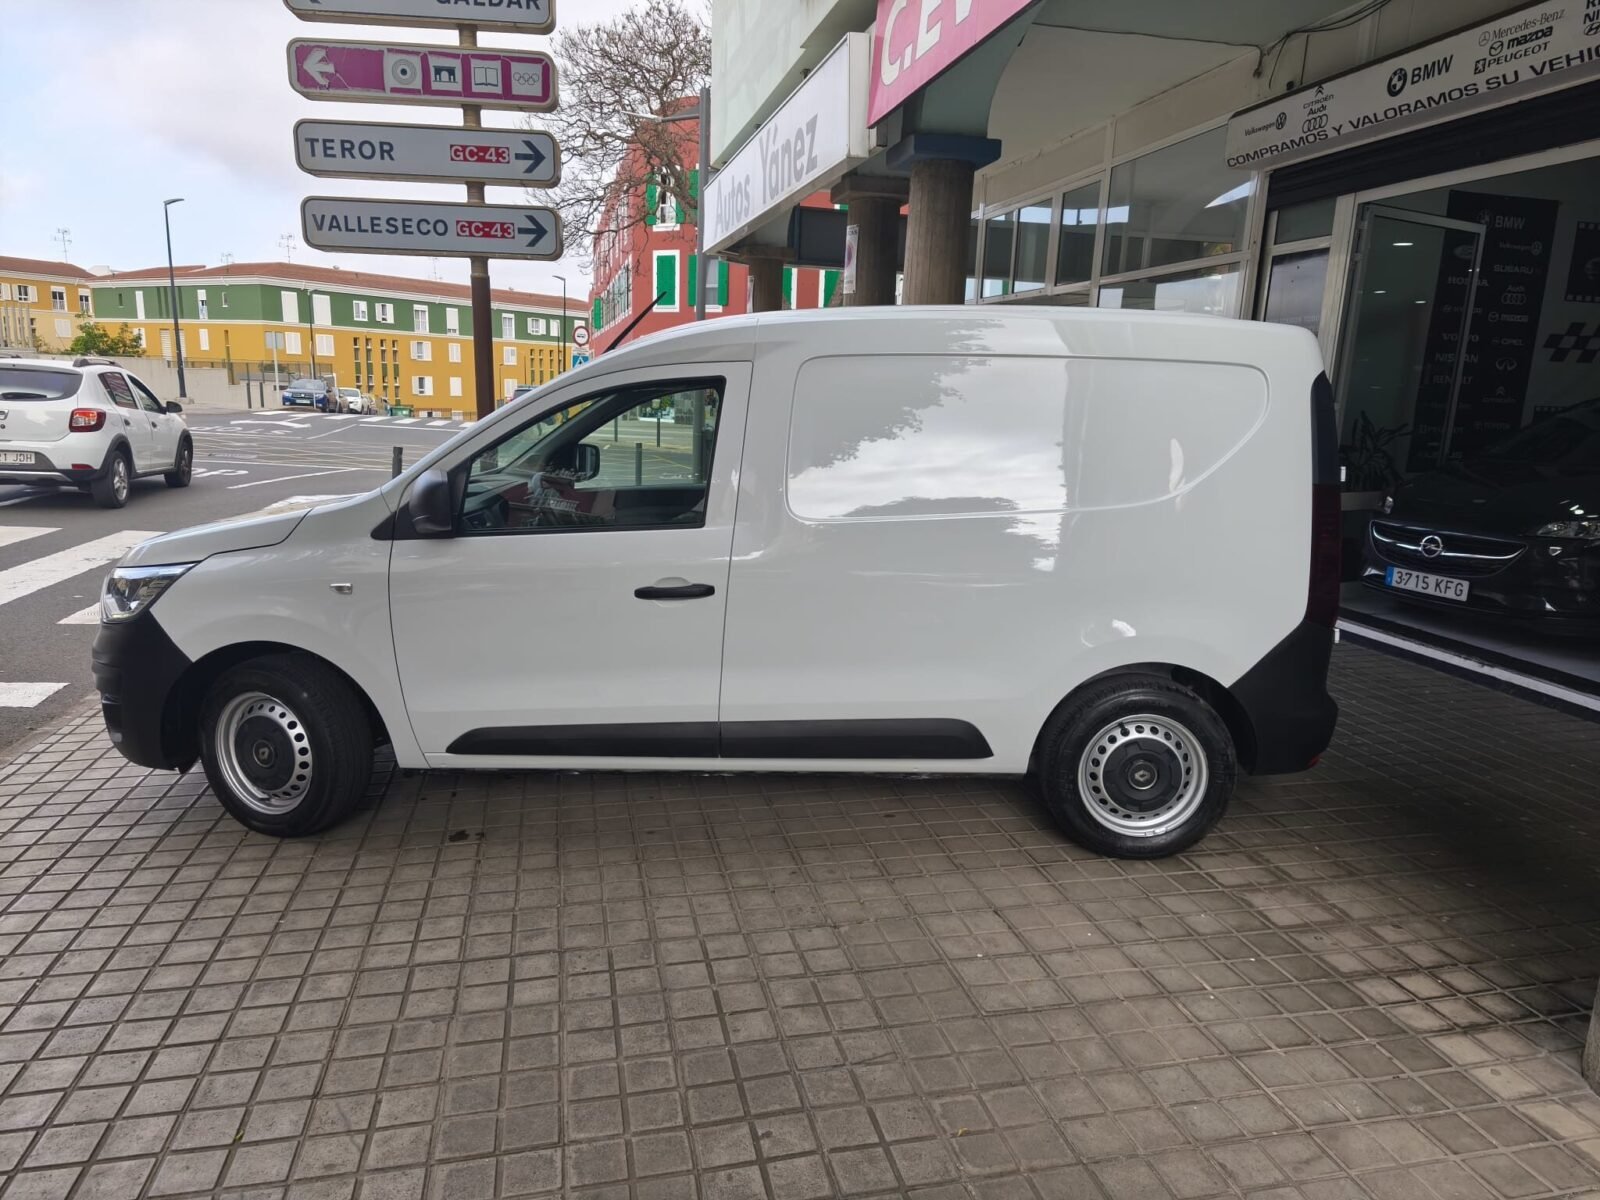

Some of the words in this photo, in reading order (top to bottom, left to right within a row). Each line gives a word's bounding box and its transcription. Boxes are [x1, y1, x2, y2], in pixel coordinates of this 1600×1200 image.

[1491, 9, 1566, 41] Mercedes-Benz
[1487, 41, 1550, 68] PEUGEOT
[1410, 55, 1453, 86] BMW
[1226, 127, 1330, 170] COMPRAMOS
[1332, 122, 1343, 138] Y
[1349, 82, 1480, 131] VALORAMOS
[1485, 69, 1520, 92] SU
[1307, 104, 1328, 117] Audi
[1244, 121, 1276, 137] Volkswagen
[304, 137, 395, 162] TEROR
[451, 145, 510, 163] GC-43
[714, 173, 751, 240] Autos
[759, 112, 818, 205] Yánez
[311, 213, 449, 237] VALLESECO
[456, 222, 515, 239] GC-43
[1495, 216, 1526, 230] BMW
[1395, 571, 1430, 590] 3715
[1434, 578, 1463, 597] KFG
